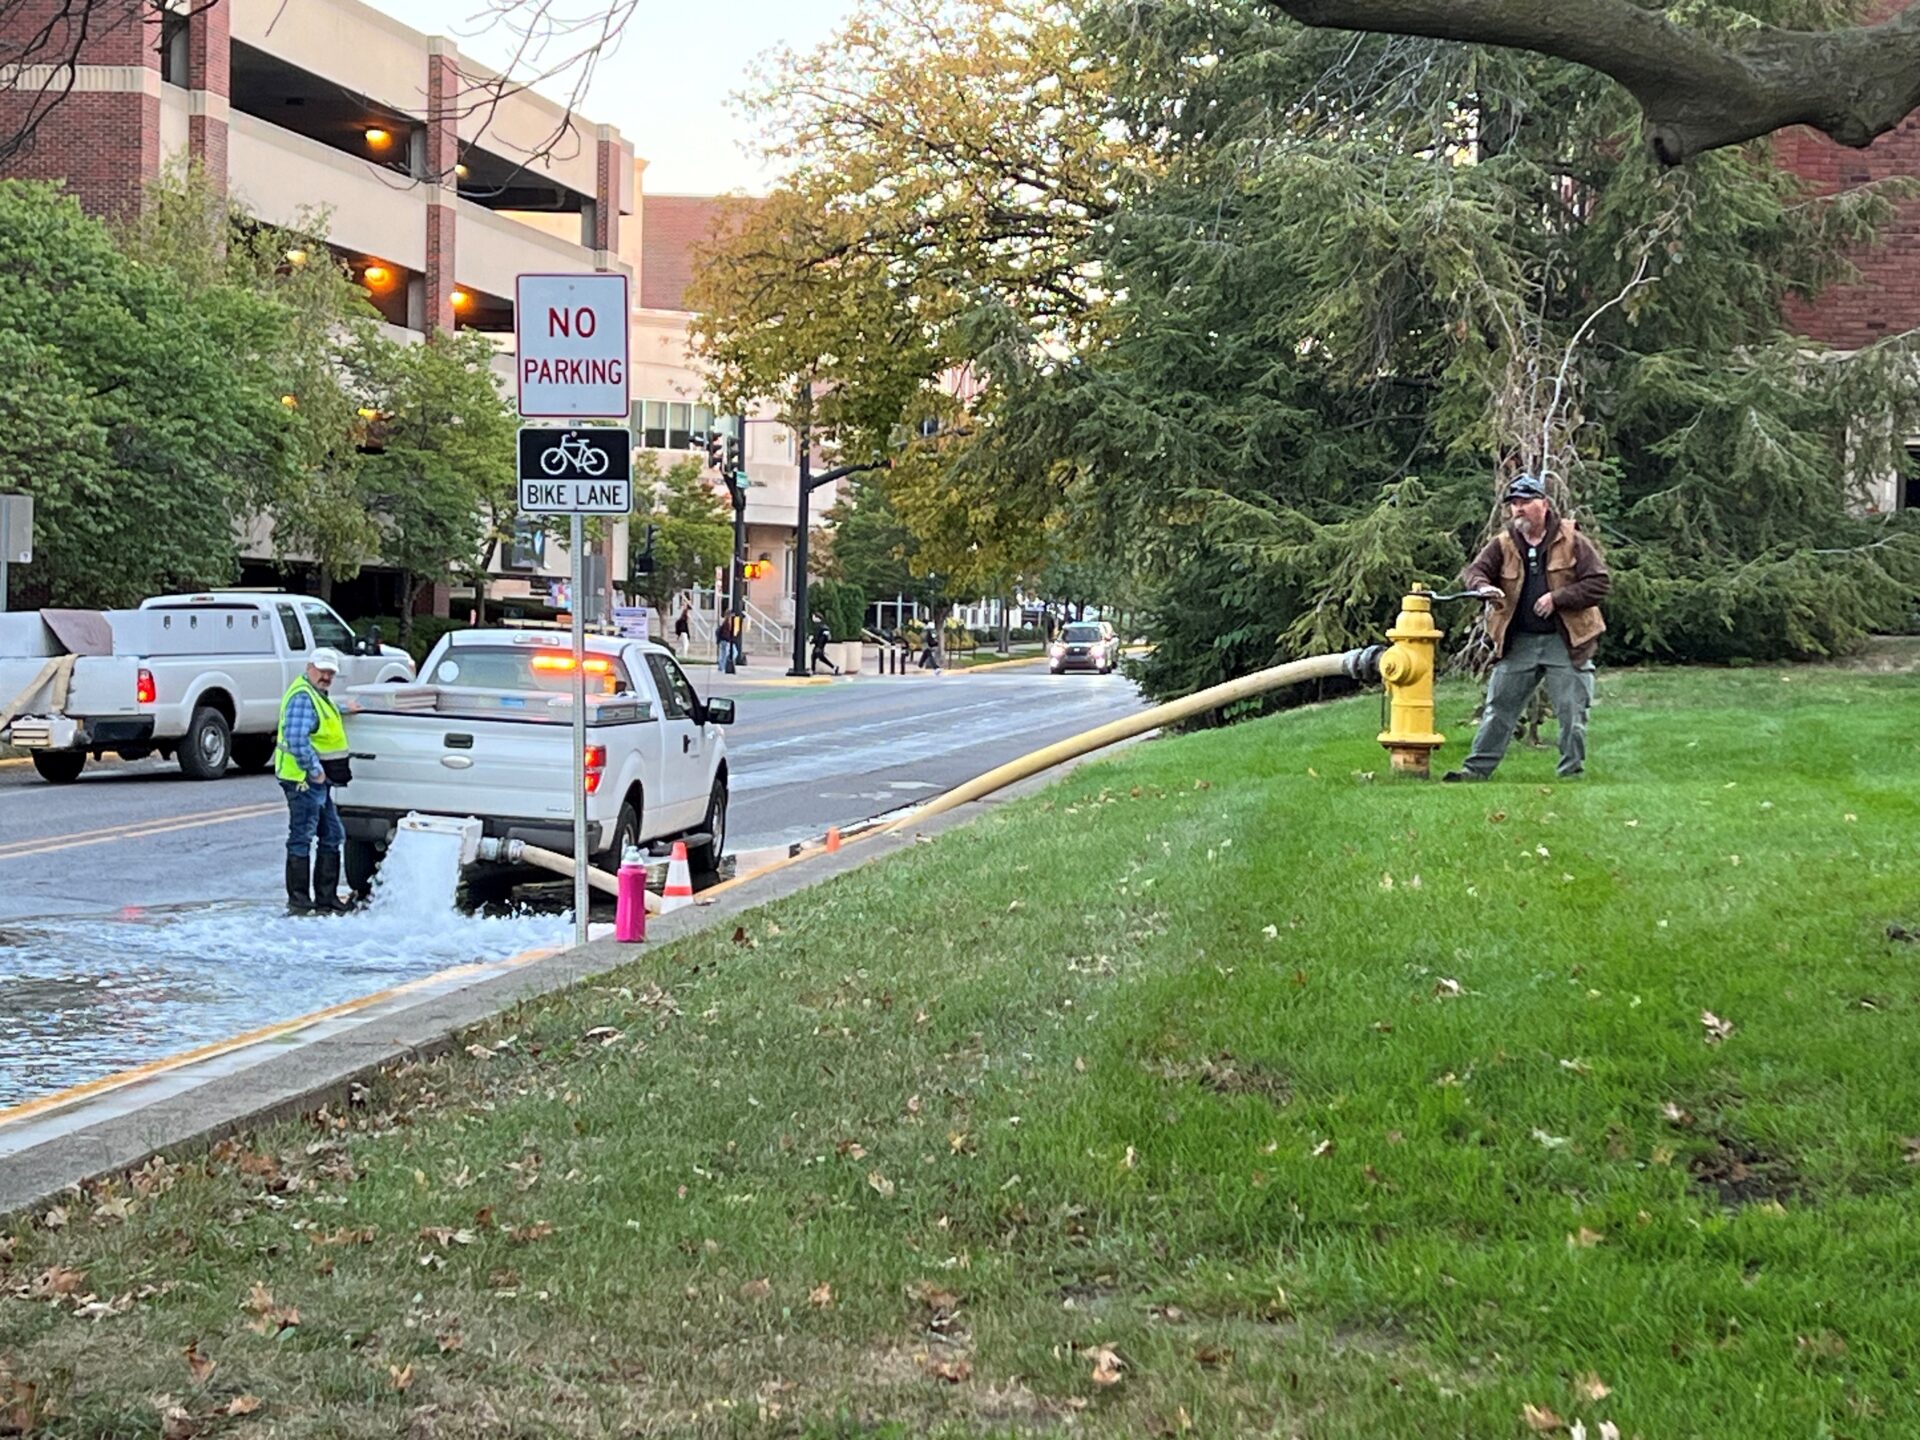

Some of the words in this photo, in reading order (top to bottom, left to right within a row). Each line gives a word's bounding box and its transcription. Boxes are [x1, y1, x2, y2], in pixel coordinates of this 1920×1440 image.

[548, 306, 596, 339] NO
[524, 358, 622, 385] PARKING
[527, 484, 568, 505] BIKE
[575, 484, 623, 506] LANE
